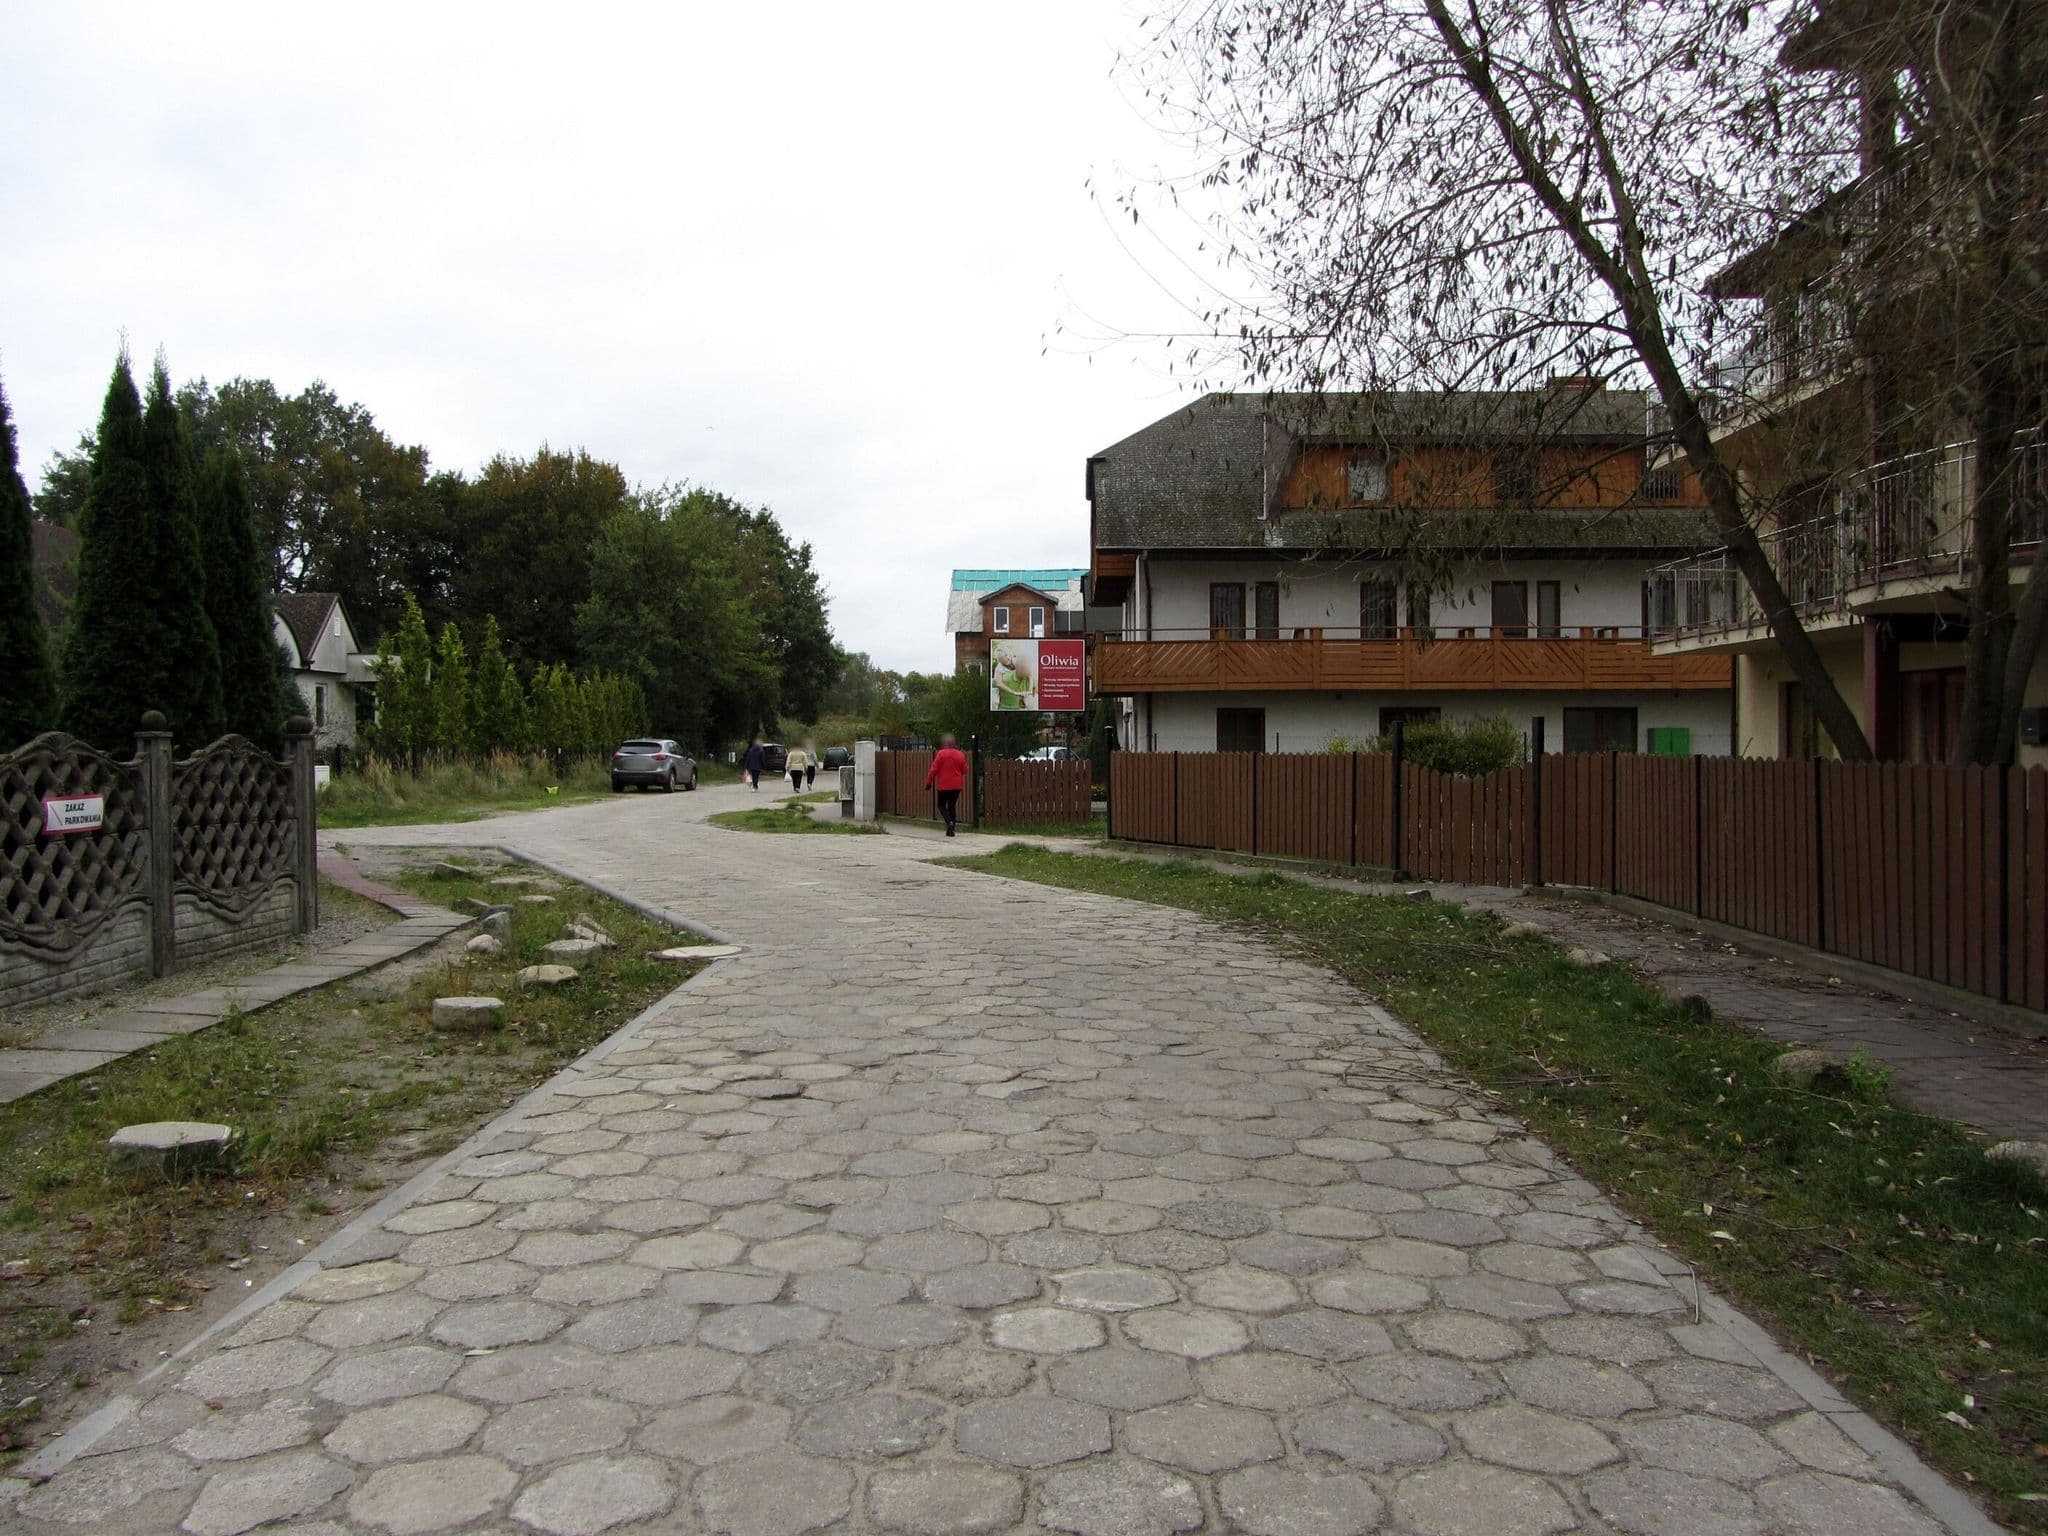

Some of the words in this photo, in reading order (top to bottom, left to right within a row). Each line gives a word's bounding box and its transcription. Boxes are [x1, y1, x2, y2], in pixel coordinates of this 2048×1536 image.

[1040, 654, 1079, 666] Oliwia
[65, 803, 84, 812] ZAKAZ
[65, 815, 100, 825] PARKOWANIA
